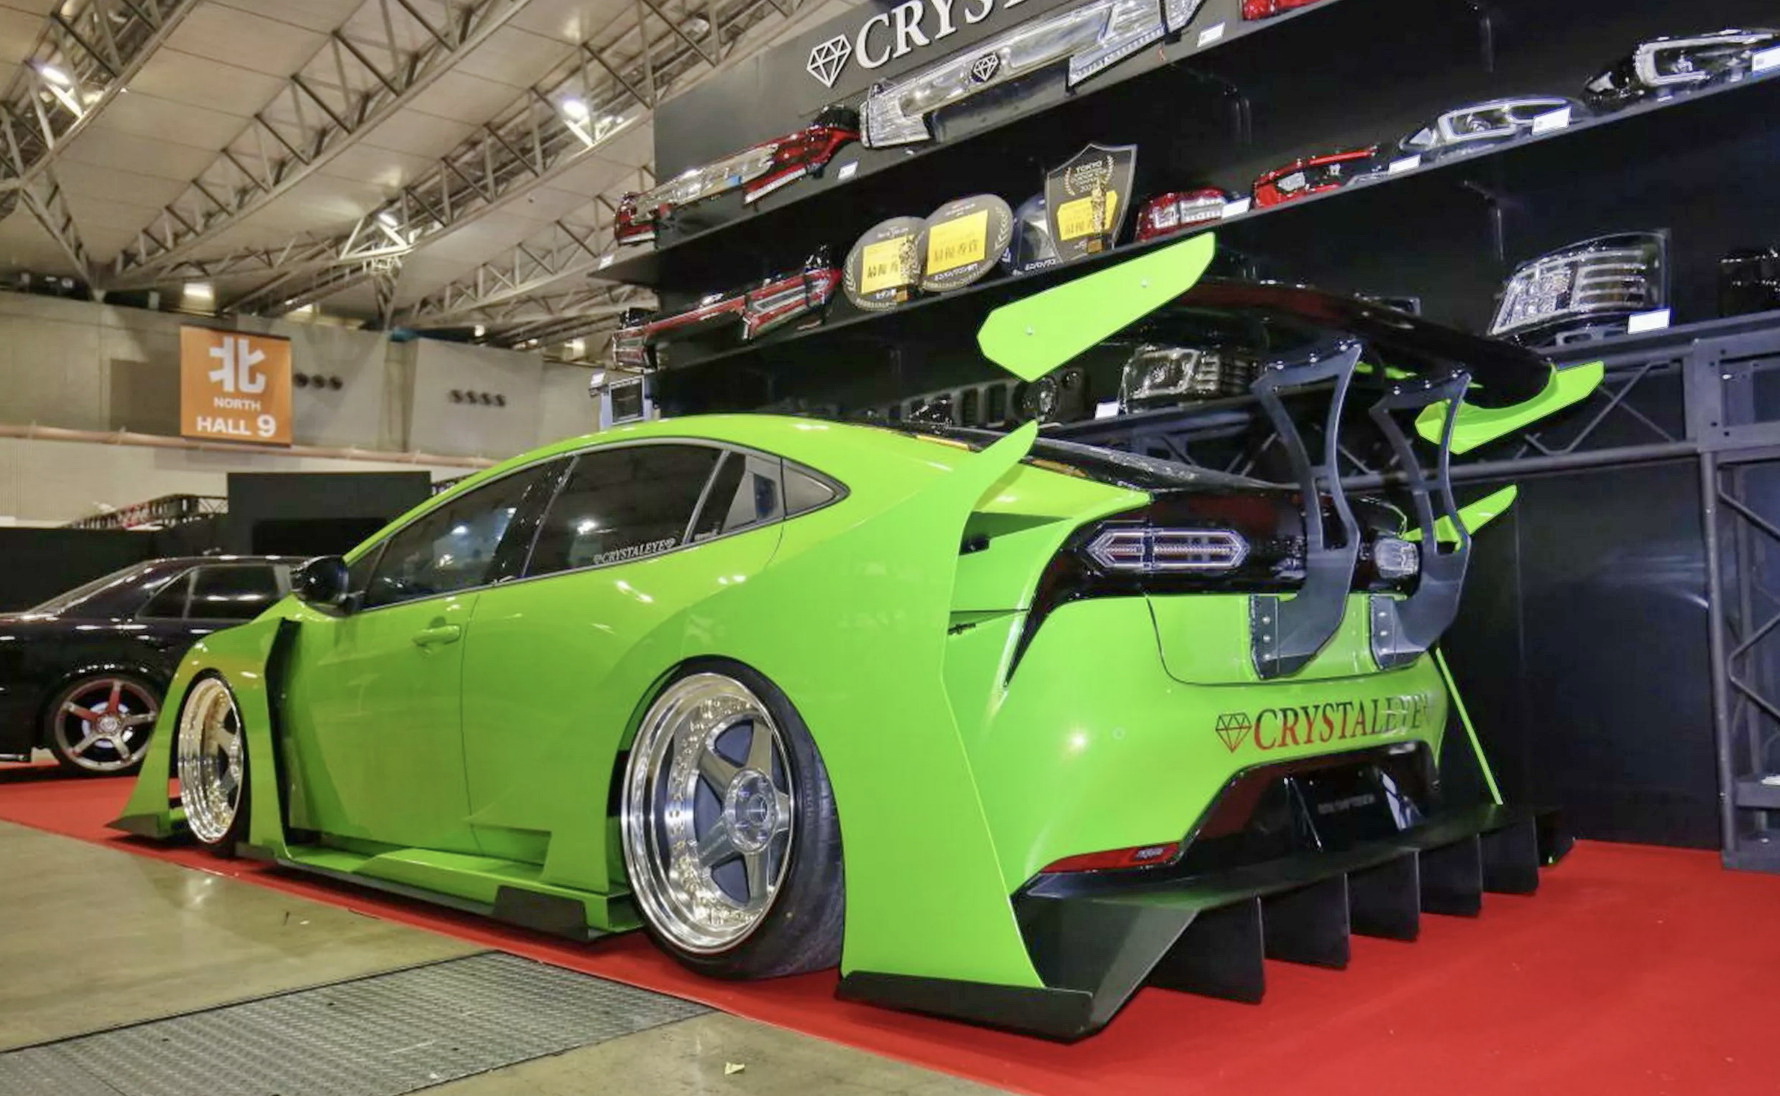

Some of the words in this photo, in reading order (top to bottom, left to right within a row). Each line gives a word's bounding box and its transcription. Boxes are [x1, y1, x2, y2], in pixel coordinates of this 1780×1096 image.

[208, 336, 266, 393] 北
[214, 397, 261, 410] NORTH
[196, 415, 251, 436] HALL
[257, 413, 276, 438] 9
